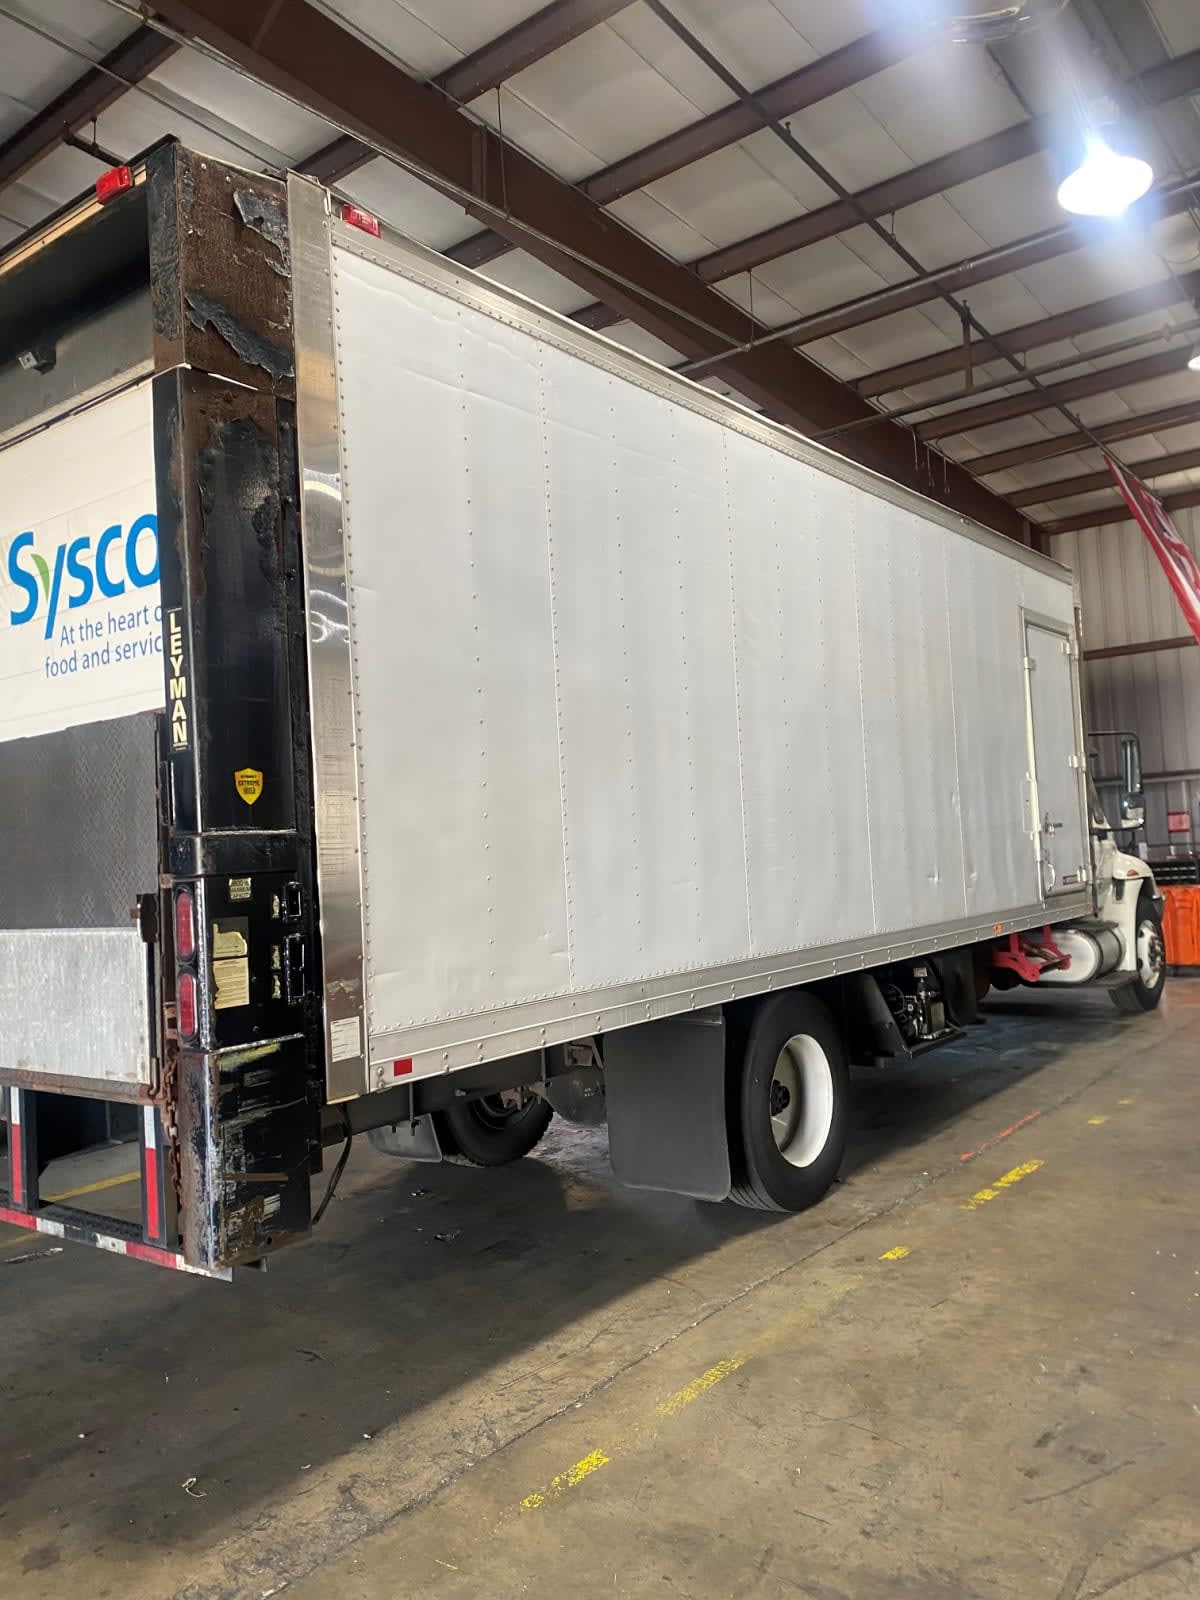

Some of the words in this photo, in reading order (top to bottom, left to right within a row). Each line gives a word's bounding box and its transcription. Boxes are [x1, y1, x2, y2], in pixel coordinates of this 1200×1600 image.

[8, 513, 160, 640] Sysco
[45, 651, 77, 678] food
[82, 641, 110, 670] and
[60, 625, 75, 647] At
[79, 618, 103, 641] the
[108, 606, 149, 634] heart
[169, 612, 188, 743] LEYMAN
